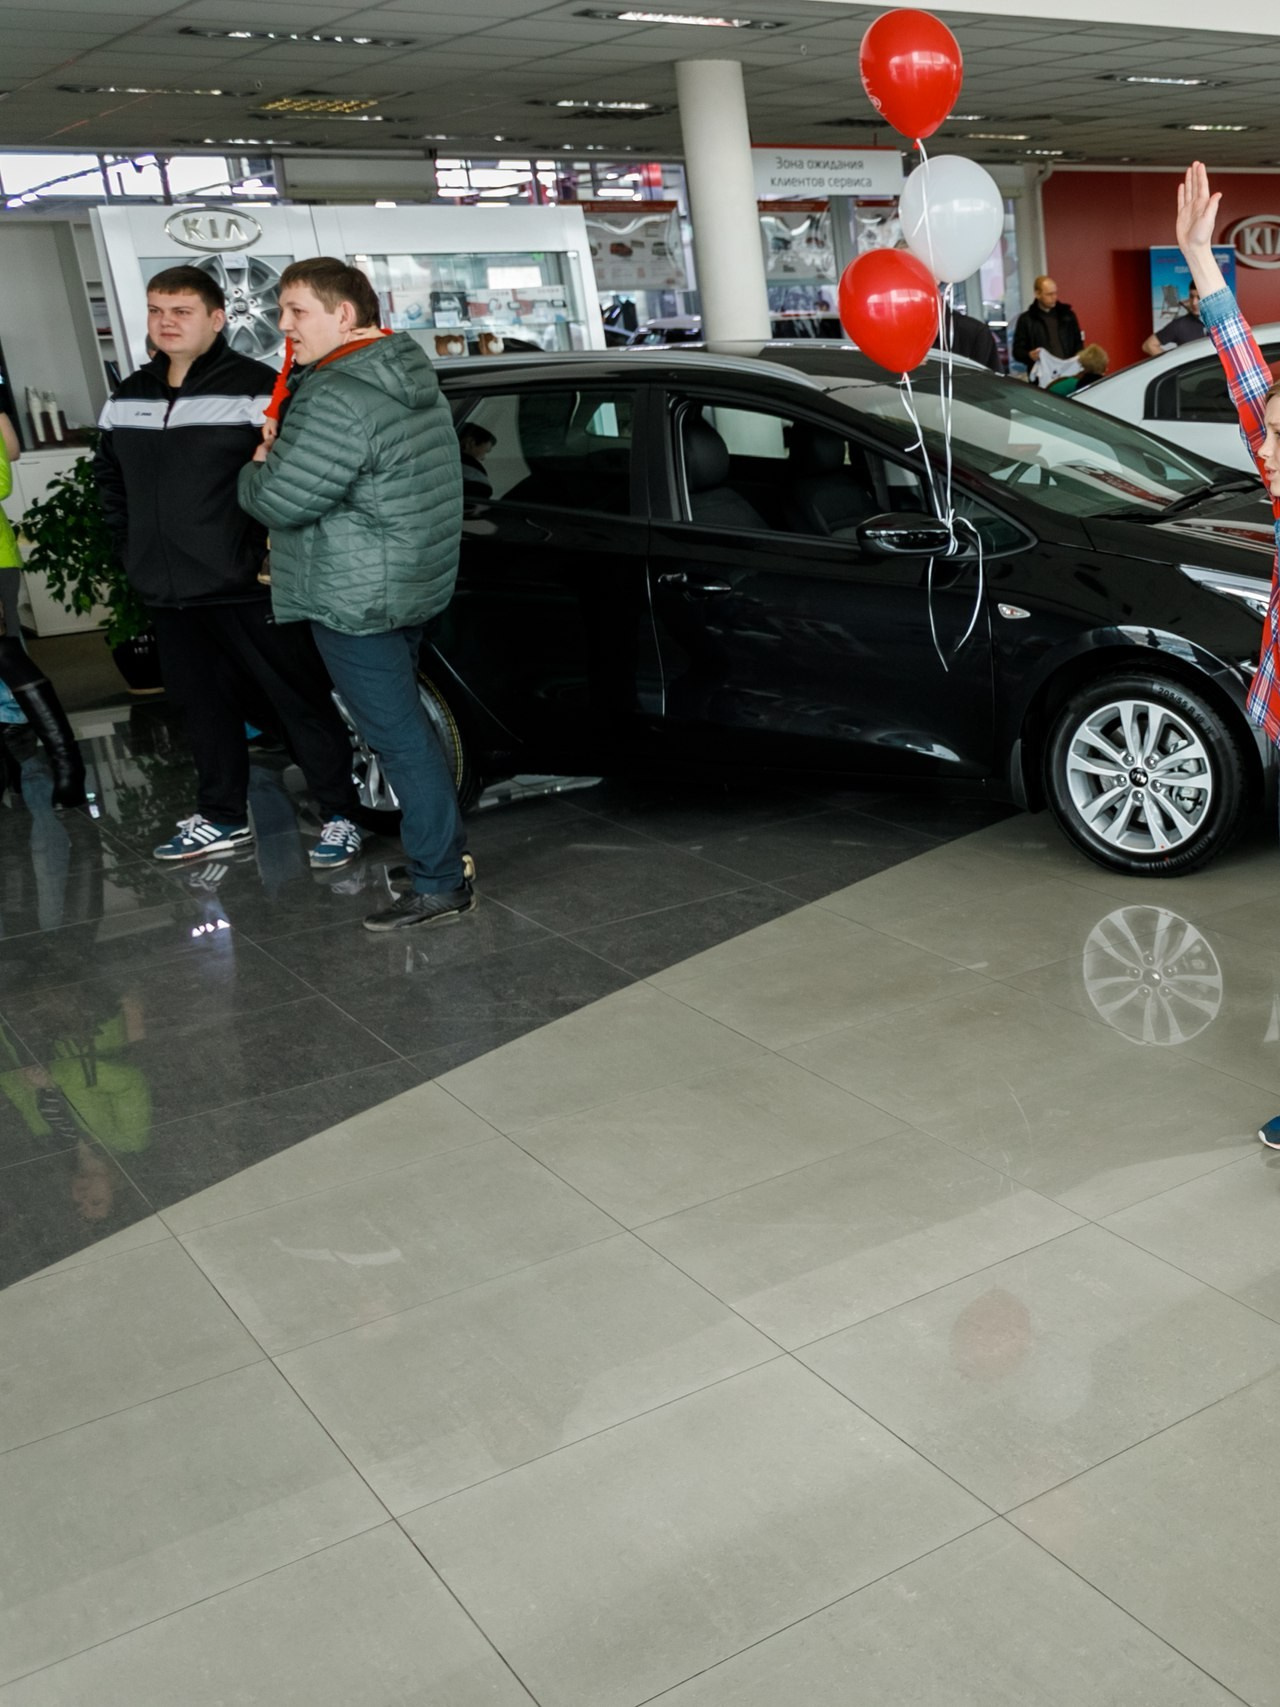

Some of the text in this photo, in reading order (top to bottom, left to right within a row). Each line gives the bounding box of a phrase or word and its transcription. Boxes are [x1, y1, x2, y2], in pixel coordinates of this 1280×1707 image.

[775, 156, 865, 171] Зона ожидания
[770, 176, 873, 189] клиентов сервиса
[181, 216, 249, 242] KIA
